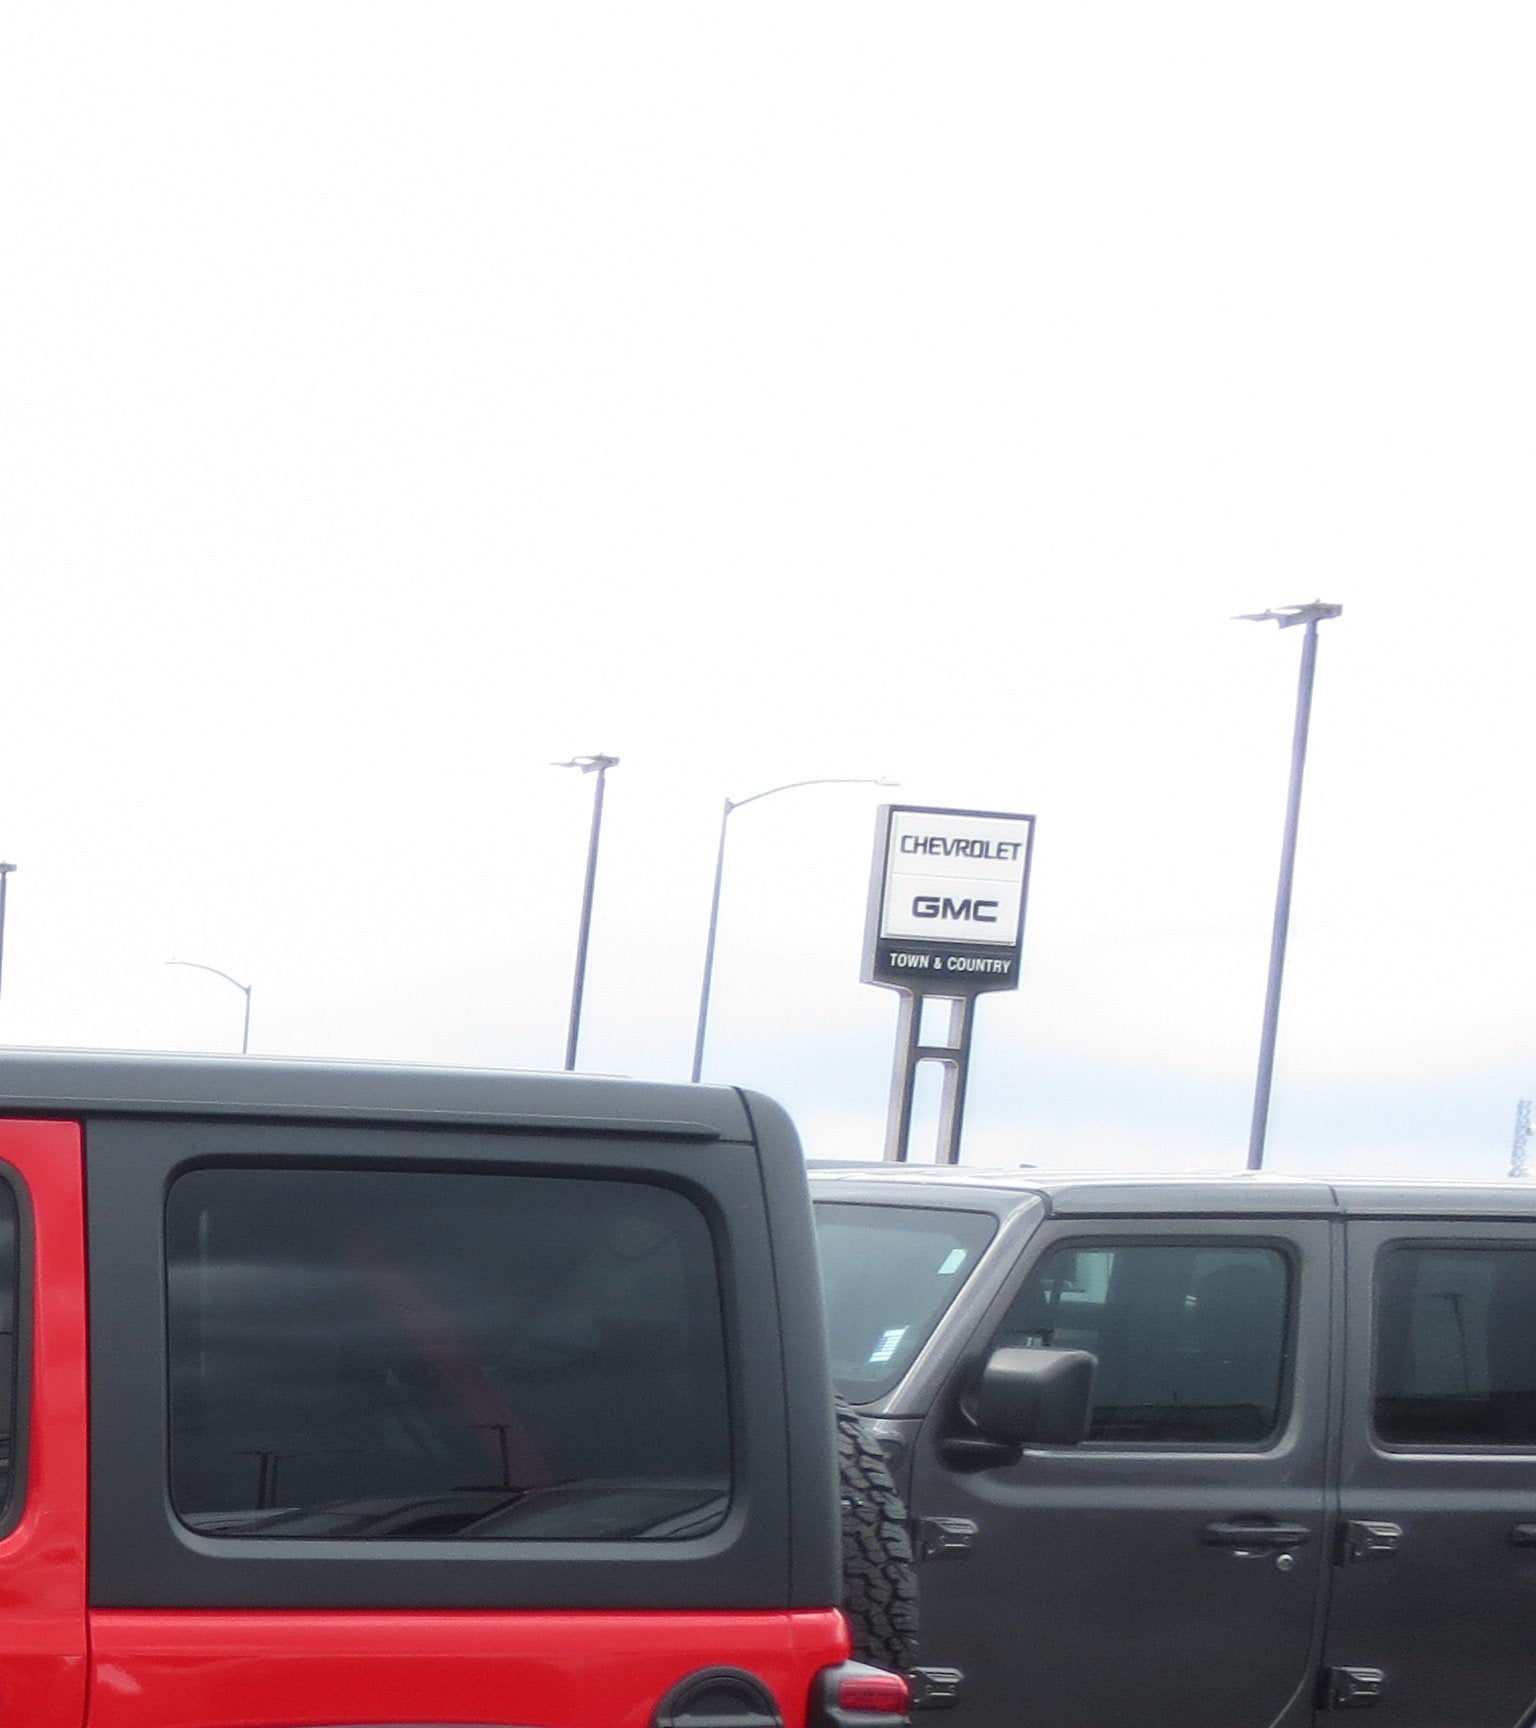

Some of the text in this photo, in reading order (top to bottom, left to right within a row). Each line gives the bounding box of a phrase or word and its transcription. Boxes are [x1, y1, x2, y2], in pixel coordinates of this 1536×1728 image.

[900, 834, 1022, 861] CHEVROLET
[912, 895, 999, 922] GMC
[890, 953, 1011, 973] TOWN & COUNTRY
